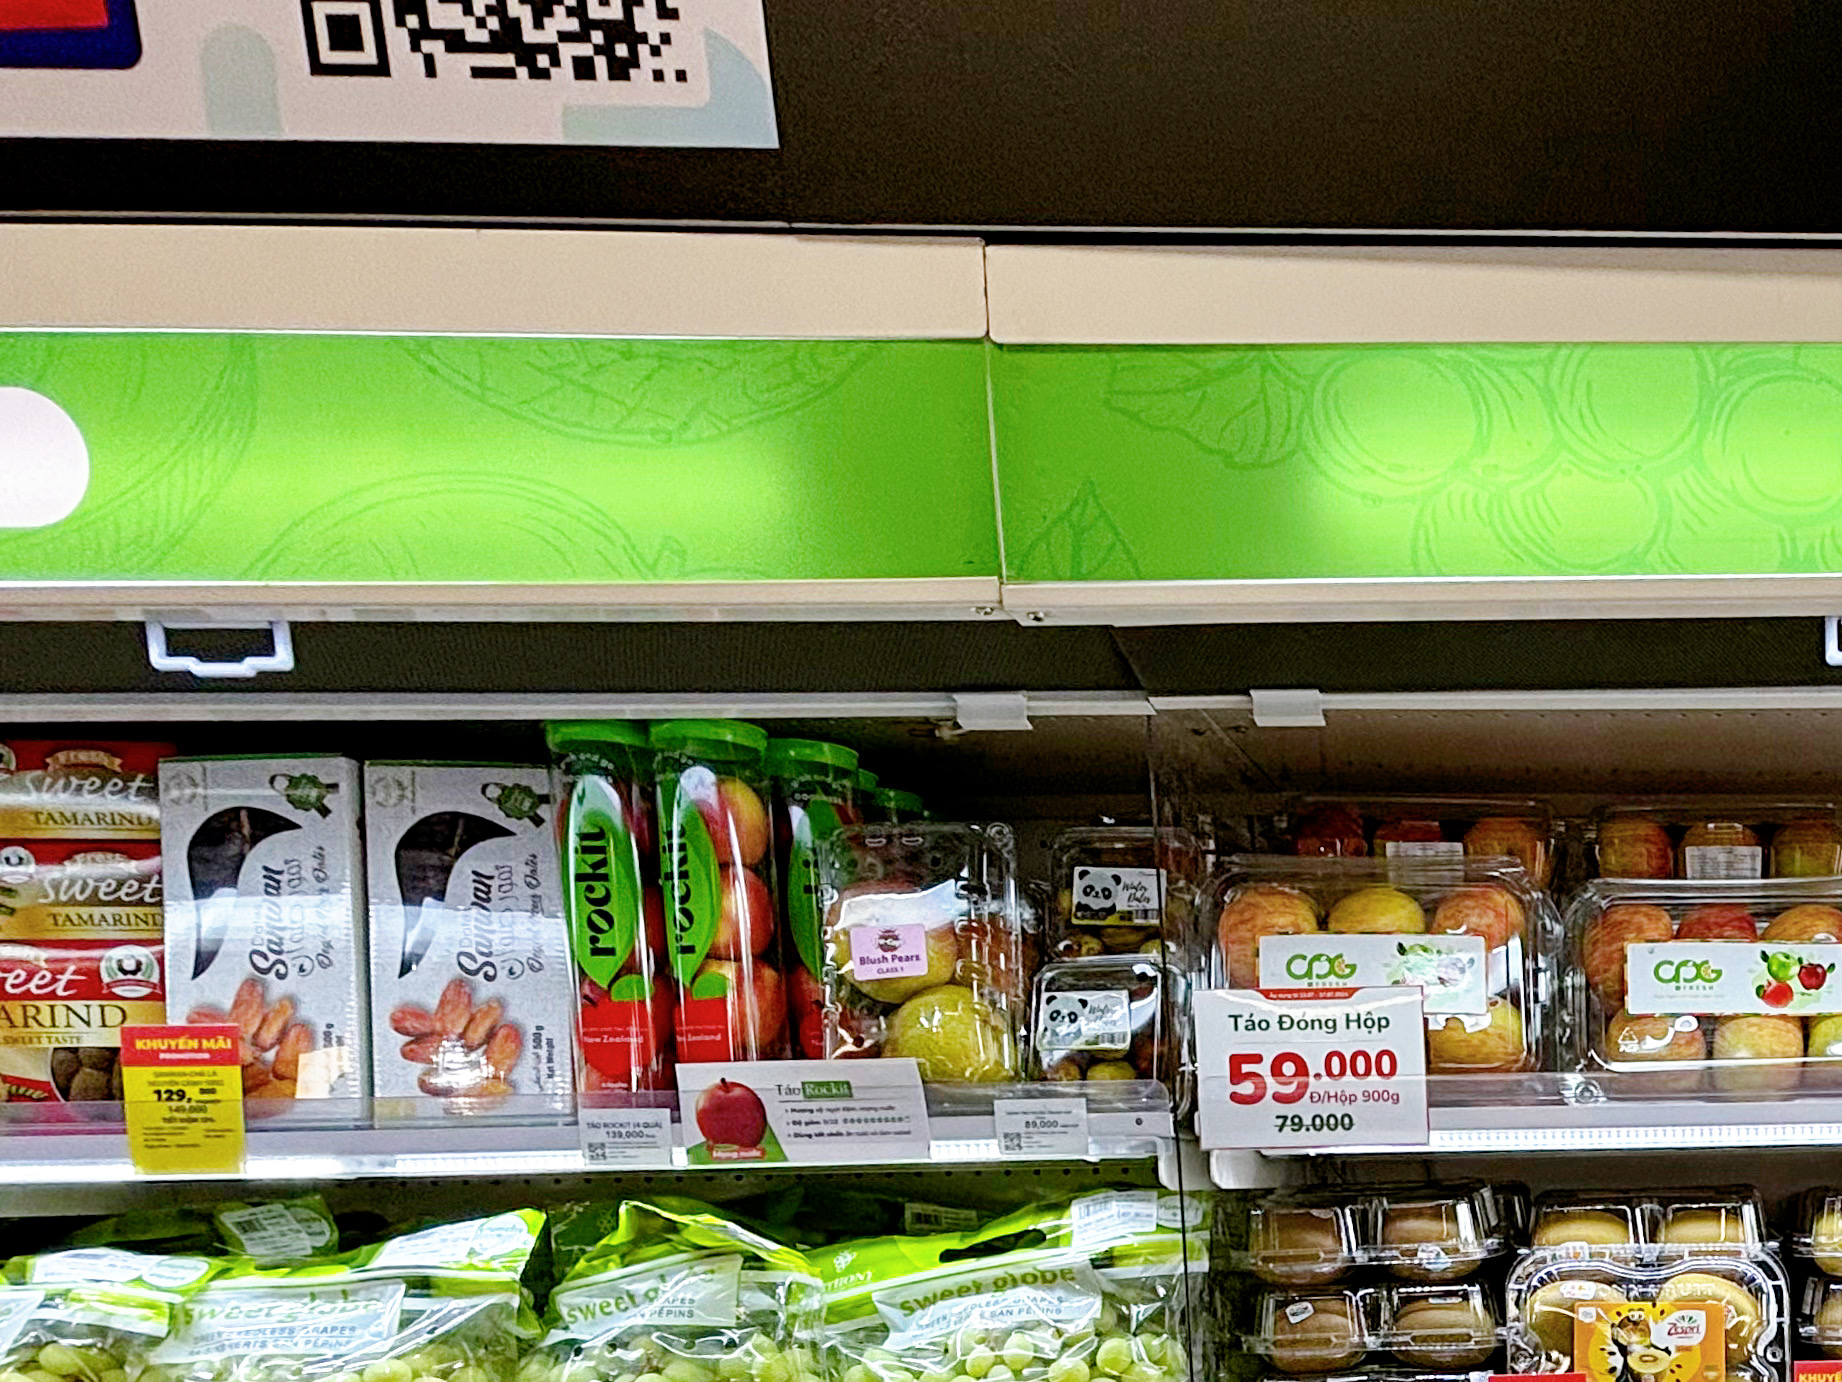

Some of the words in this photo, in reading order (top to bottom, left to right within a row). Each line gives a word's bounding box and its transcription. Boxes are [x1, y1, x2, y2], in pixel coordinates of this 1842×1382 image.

[575, 826, 616, 957] rockit
[664, 825, 696, 954] rockit
[859, 955, 888, 967] Blush
[891, 953, 921, 963] Pears
[1228, 1013, 1270, 1032] Táo
[1277, 1012, 1337, 1034] Đóng
[1346, 1011, 1390, 1034] Hộp
[136, 1035, 198, 1050] KHUYẾN
[775, 1084, 801, 1096] Táo
[805, 1082, 850, 1097] Rockit
[1309, 1091, 1358, 1106] Đ/Hộp
[1362, 1089, 1400, 1104] 900g
[1275, 1113, 1354, 1132] 79.000
[1666, 1320, 1701, 1338] Zespri
